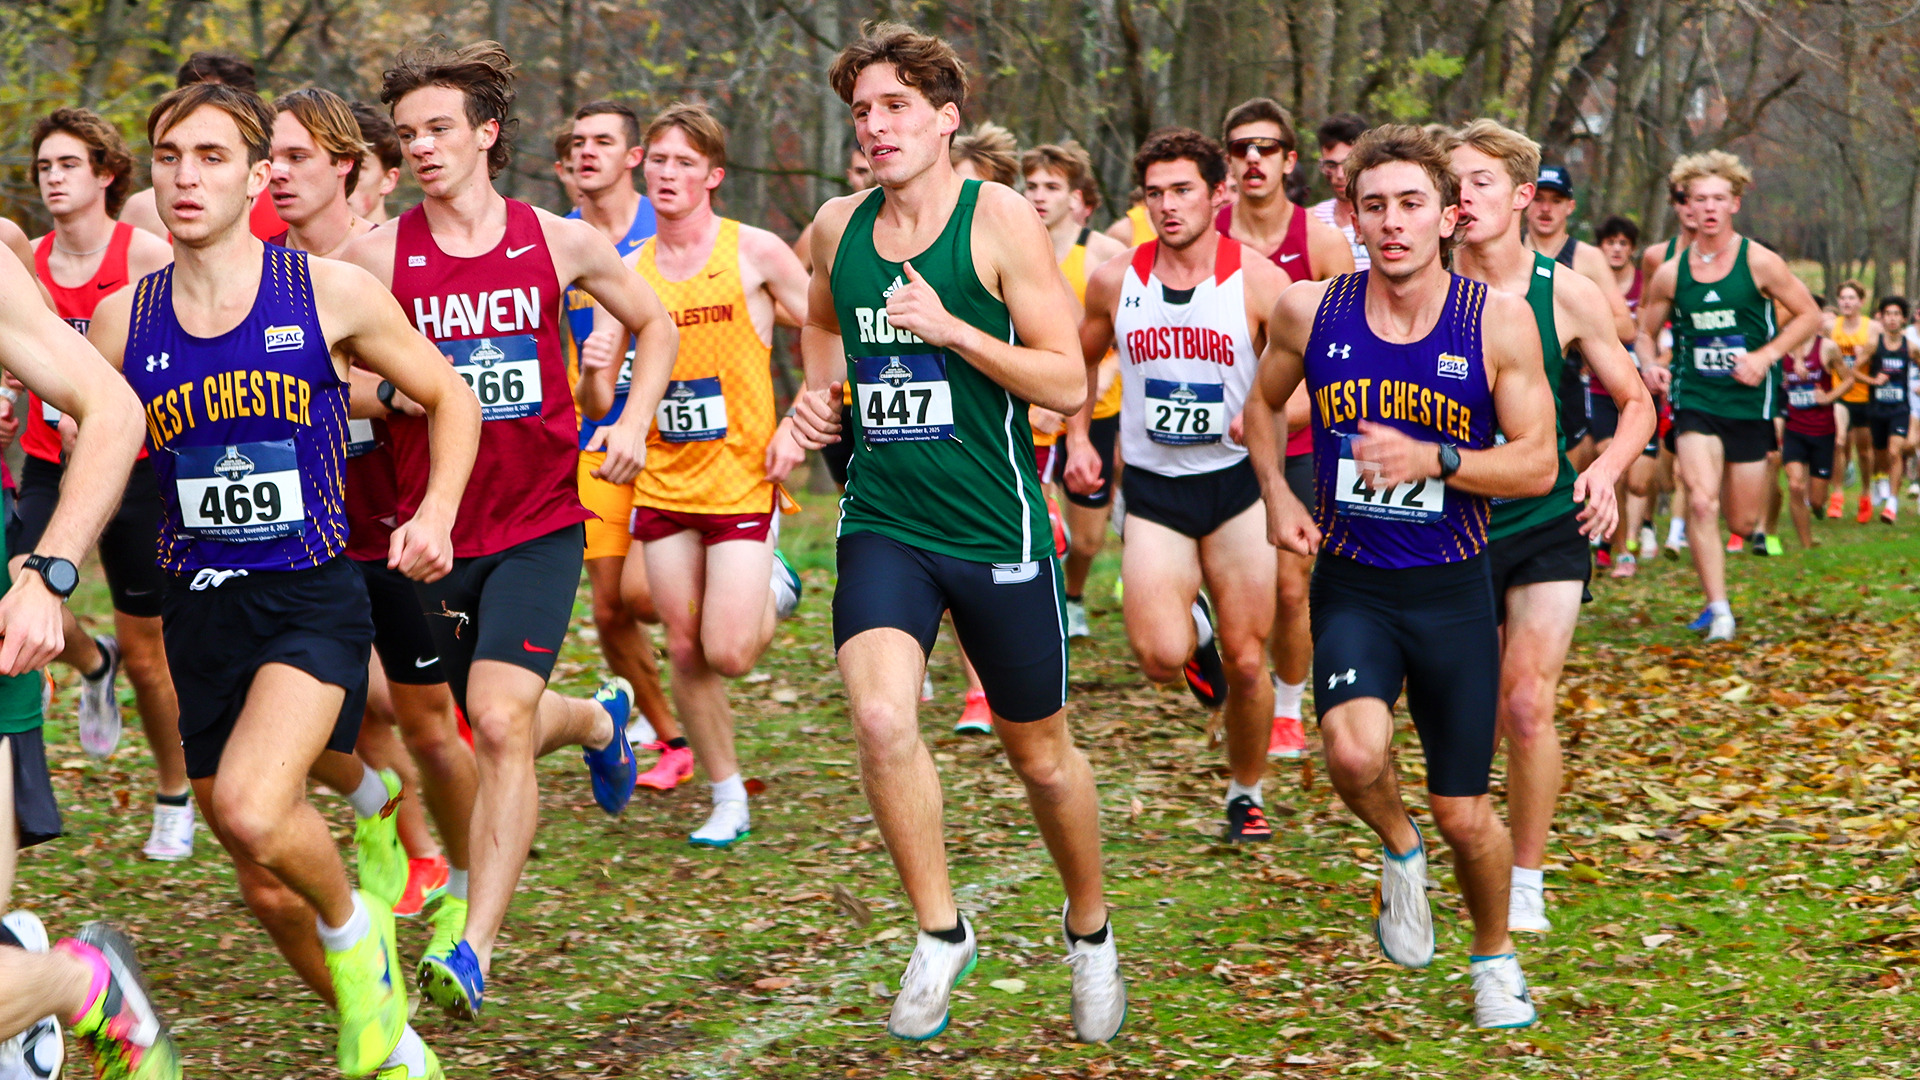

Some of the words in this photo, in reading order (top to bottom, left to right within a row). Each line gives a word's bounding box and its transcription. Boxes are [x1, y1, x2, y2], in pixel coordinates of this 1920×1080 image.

[413, 286, 540, 339] HAVEN
[668, 304, 733, 327] LESTON
[855, 307, 924, 344] RO
[266, 332, 302, 345] PSAC
[1126, 326, 1234, 366] FROSTBURG
[1439, 360, 1467, 374] PSAC
[146, 381, 196, 451] WEST
[203, 369, 312, 427] CHESTER
[663, 403, 708, 431] 151
[867, 389, 932, 426] 447
[1155, 405, 1210, 434] 278
[1315, 378, 1371, 429] WEST
[1379, 379, 1471, 443] CHESTER
[199, 481, 282, 525] 469
[1352, 468, 1426, 507] 472
[200, 528, 221, 536] ATLANTIC
[221, 527, 240, 535] REGION
[243, 525, 271, 534] November
[276, 523, 290, 531] 2025
